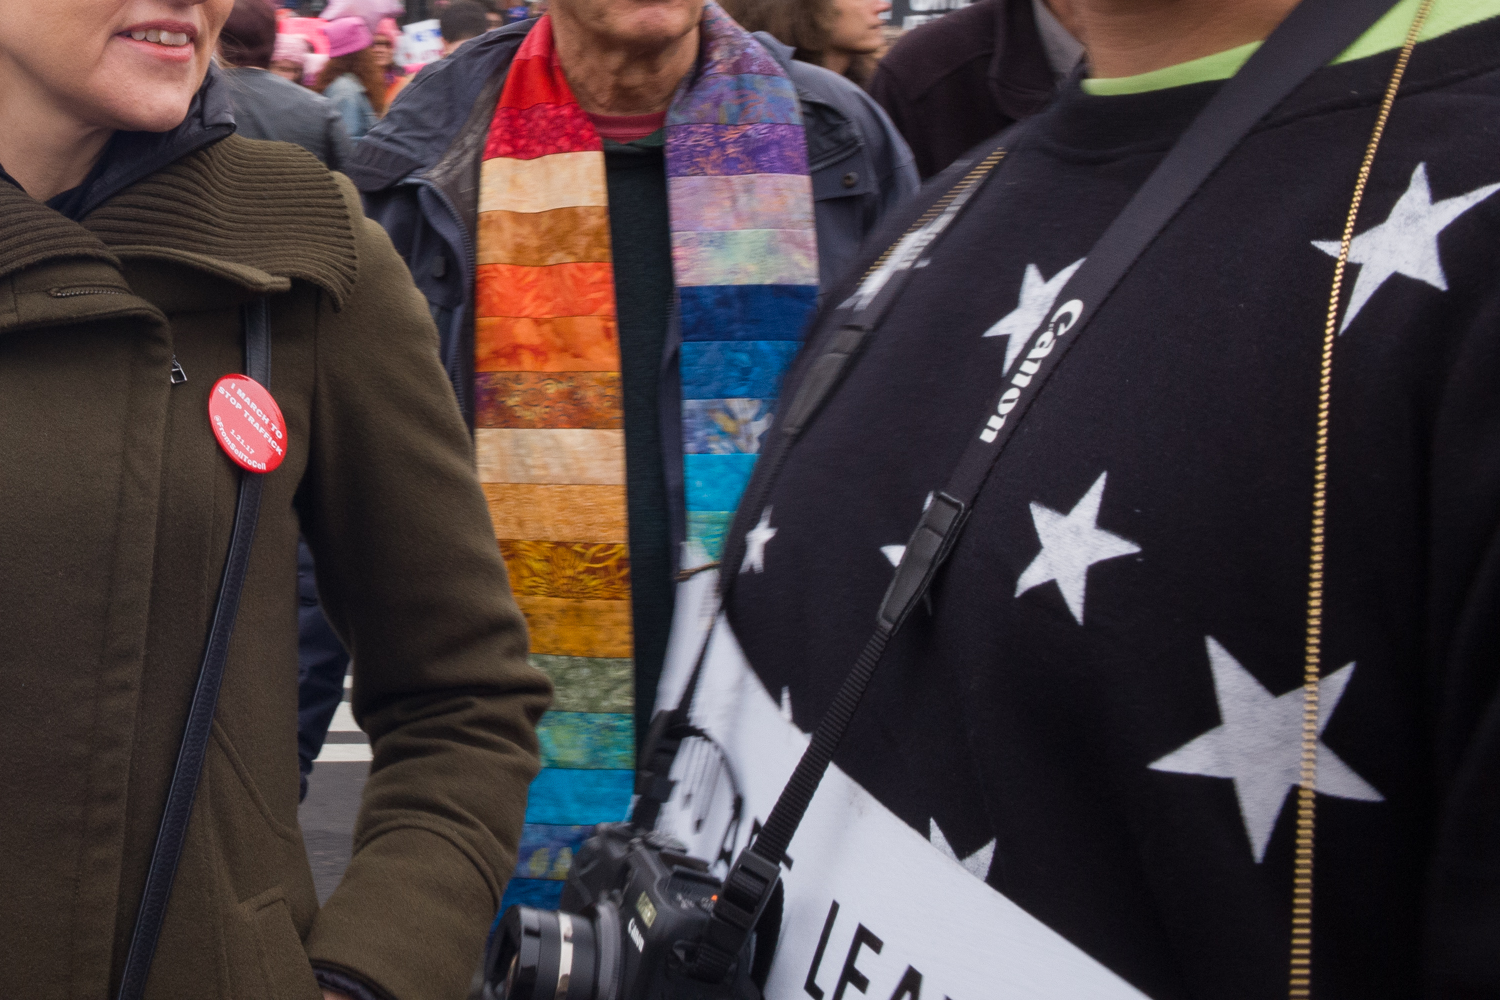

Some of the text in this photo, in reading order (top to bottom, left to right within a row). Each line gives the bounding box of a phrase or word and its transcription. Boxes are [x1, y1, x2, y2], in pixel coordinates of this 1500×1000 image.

[979, 299, 1084, 443] Canon
[218, 386, 283, 456] STOP TRAFFICK
[230, 429, 255, 455] 1.21.17
[236, 388, 270, 425] MARCH
[270, 423, 283, 439] TO
